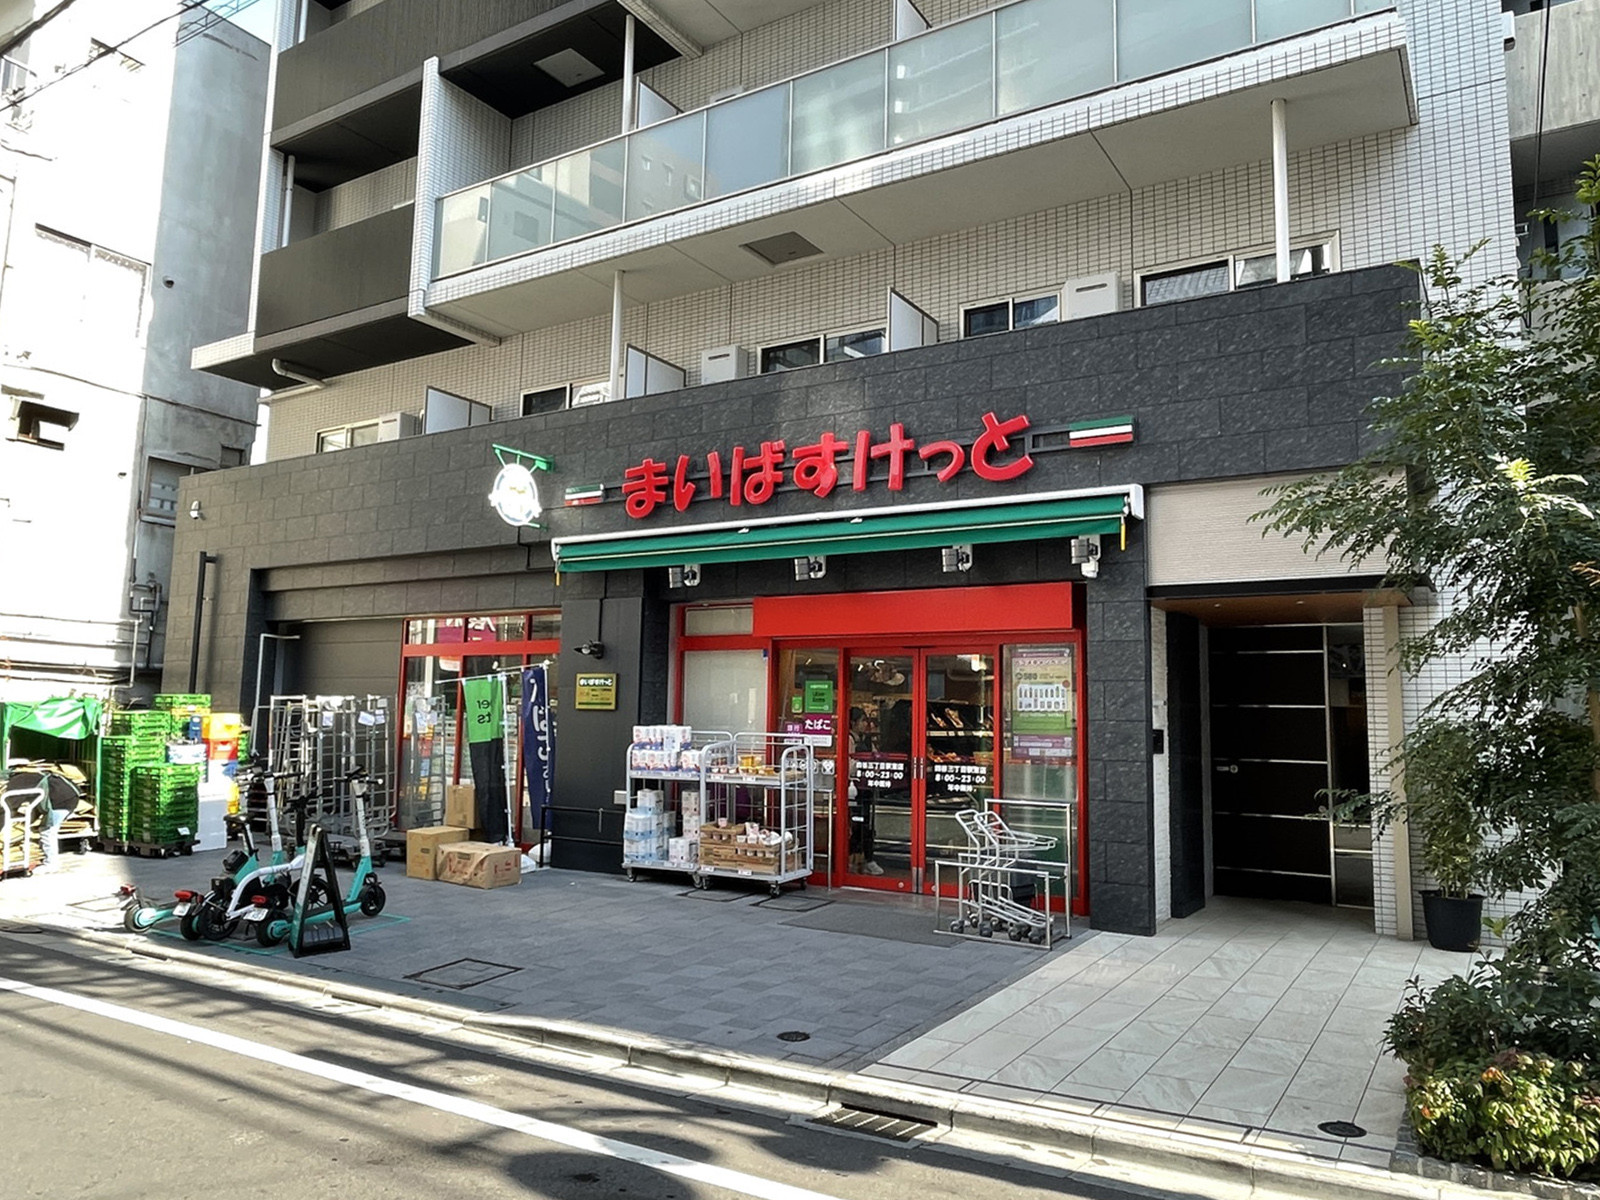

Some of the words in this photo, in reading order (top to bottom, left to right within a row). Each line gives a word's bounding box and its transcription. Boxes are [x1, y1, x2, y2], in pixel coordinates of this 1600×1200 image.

[622, 411, 1034, 519] まいばすけっと
[804, 719, 832, 731] たばこ
